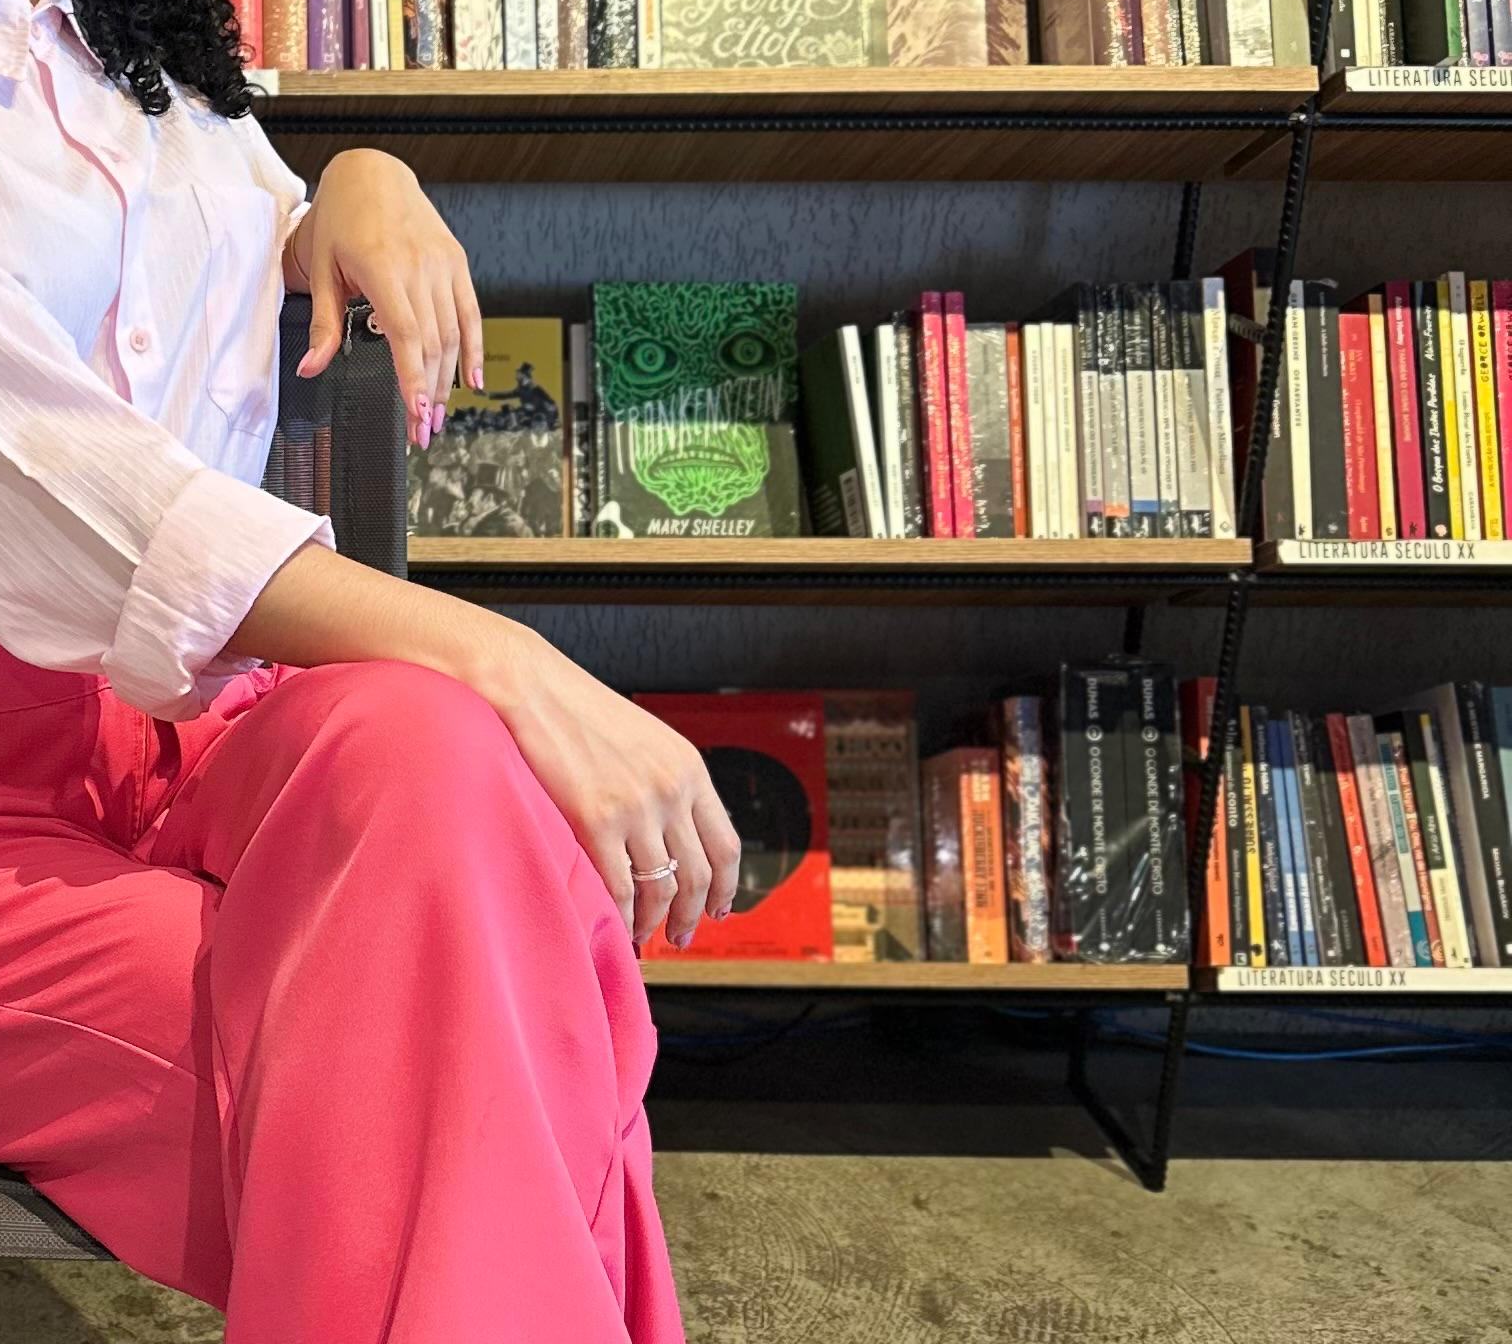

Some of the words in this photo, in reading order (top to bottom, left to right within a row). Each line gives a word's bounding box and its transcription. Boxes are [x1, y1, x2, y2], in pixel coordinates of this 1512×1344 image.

[713, 17, 803, 59] Eliot
[1368, 69, 1462, 87] LITERATURA
[615, 367, 785, 475] FRANKENSTEIN
[648, 518, 690, 535] MARY
[692, 518, 755, 535] SHELLEY
[1298, 540, 1388, 561] LITERATURA
[1454, 541, 1477, 560] XX
[1087, 677, 1098, 719] DUMAS
[1142, 678, 1153, 720] DUMAS
[1091, 759, 1103, 796] CONDE
[1147, 761, 1158, 797] CONDE
[1093, 798, 1103, 813] DE
[1148, 800, 1158, 814] DE
[1094, 816, 1106, 855] MONTE
[1150, 817, 1161, 856] MONTE
[1151, 858, 1164, 896] CRISTO
[1238, 970, 1324, 987] LITERATURA
[1389, 971, 1407, 986] XX
